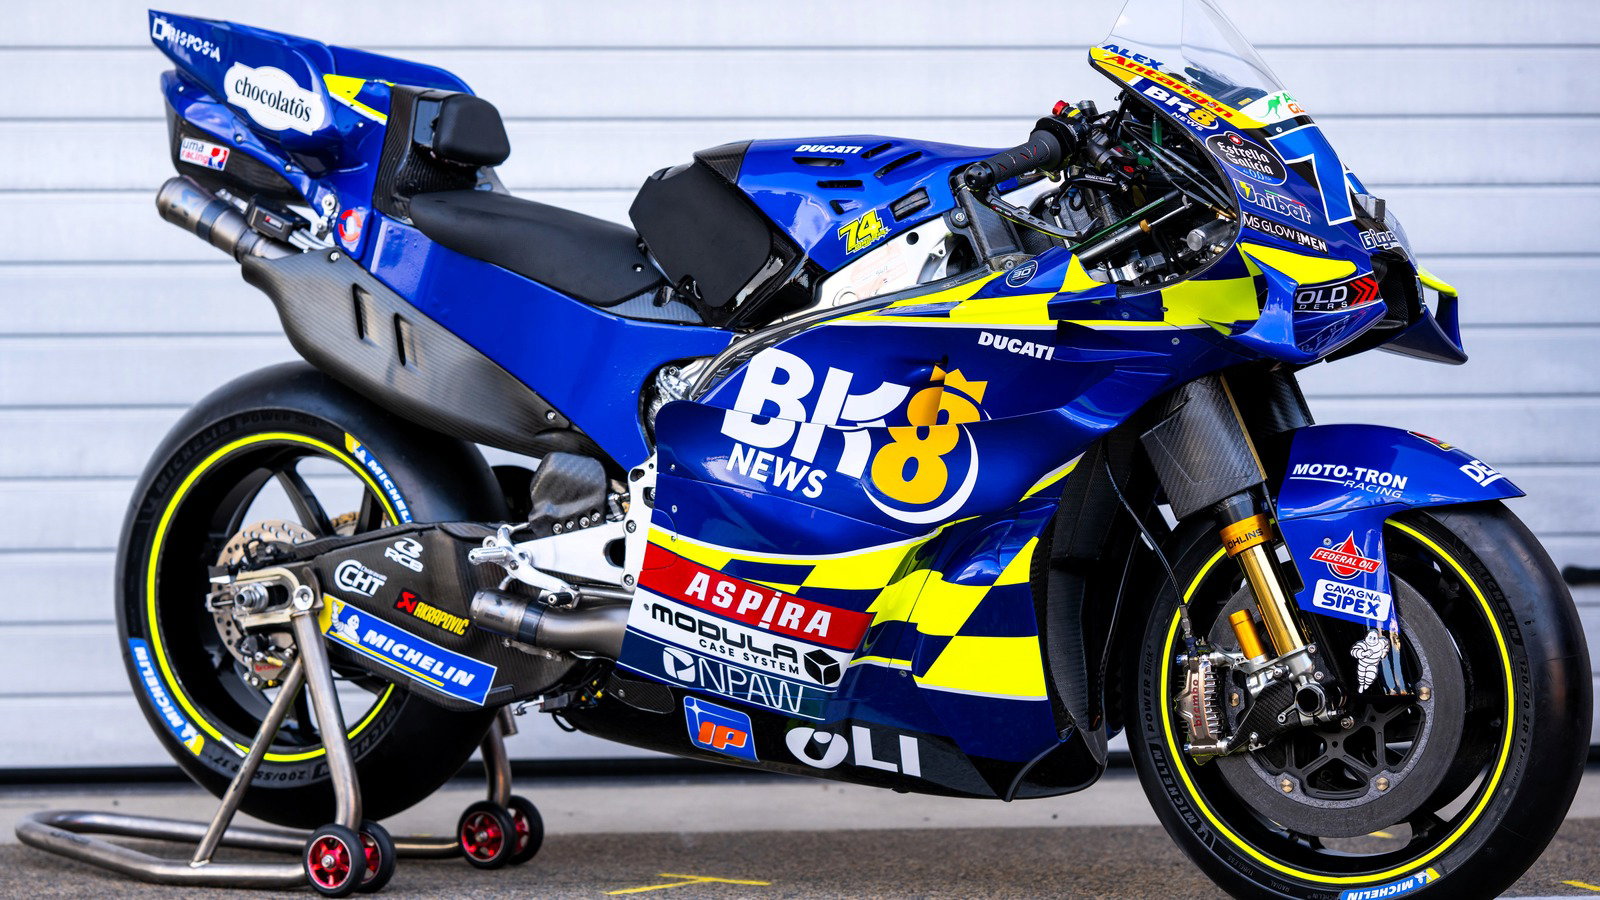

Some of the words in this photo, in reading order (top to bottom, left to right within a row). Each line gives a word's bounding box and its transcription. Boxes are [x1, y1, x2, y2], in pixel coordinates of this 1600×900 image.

[1102, 44, 1164, 71] ALEX
[1103, 55, 1234, 118] Antangin
[1142, 85, 1219, 129] BK8
[1171, 112, 1204, 131] NEWS
[795, 144, 864, 155] DUCATI
[1217, 141, 1270, 164] Estrella
[1226, 153, 1274, 176] Galicia
[1233, 178, 1312, 225] Unibat
[838, 208, 883, 255] 74
[1242, 211, 1261, 229] MS
[1261, 220, 1296, 240] GLOW
[1301, 234, 1328, 252] MEN
[1295, 286, 1348, 304] OLD
[978, 331, 1056, 361] DUCATI
[720, 346, 984, 506] BK8
[726, 443, 828, 499] NEWS
[1292, 463, 1408, 490] MOTO-TRON
[1343, 480, 1404, 499] RACING
[367, 460, 413, 524] MICHEL
[384, 547, 424, 573] RCB
[1315, 550, 1357, 567] FEDERAL
[1358, 559, 1375, 571] OIL
[340, 565, 385, 596] CHT
[1325, 583, 1382, 602] CAVAGNA
[1321, 592, 1380, 617] SIPEX
[651, 602, 798, 664] MODULA
[363, 629, 475, 688] MICHELIN
[699, 638, 735, 658] CASE
[743, 651, 800, 675] SYSTEM
[134, 647, 184, 728] MICHELIN
[699, 657, 804, 713] NPAW
[1189, 678, 1203, 727] brembo
[1143, 680, 1154, 732] POWER
[1151, 748, 1198, 824] MICHELIN
[1346, 878, 1414, 900] MICHELIN
